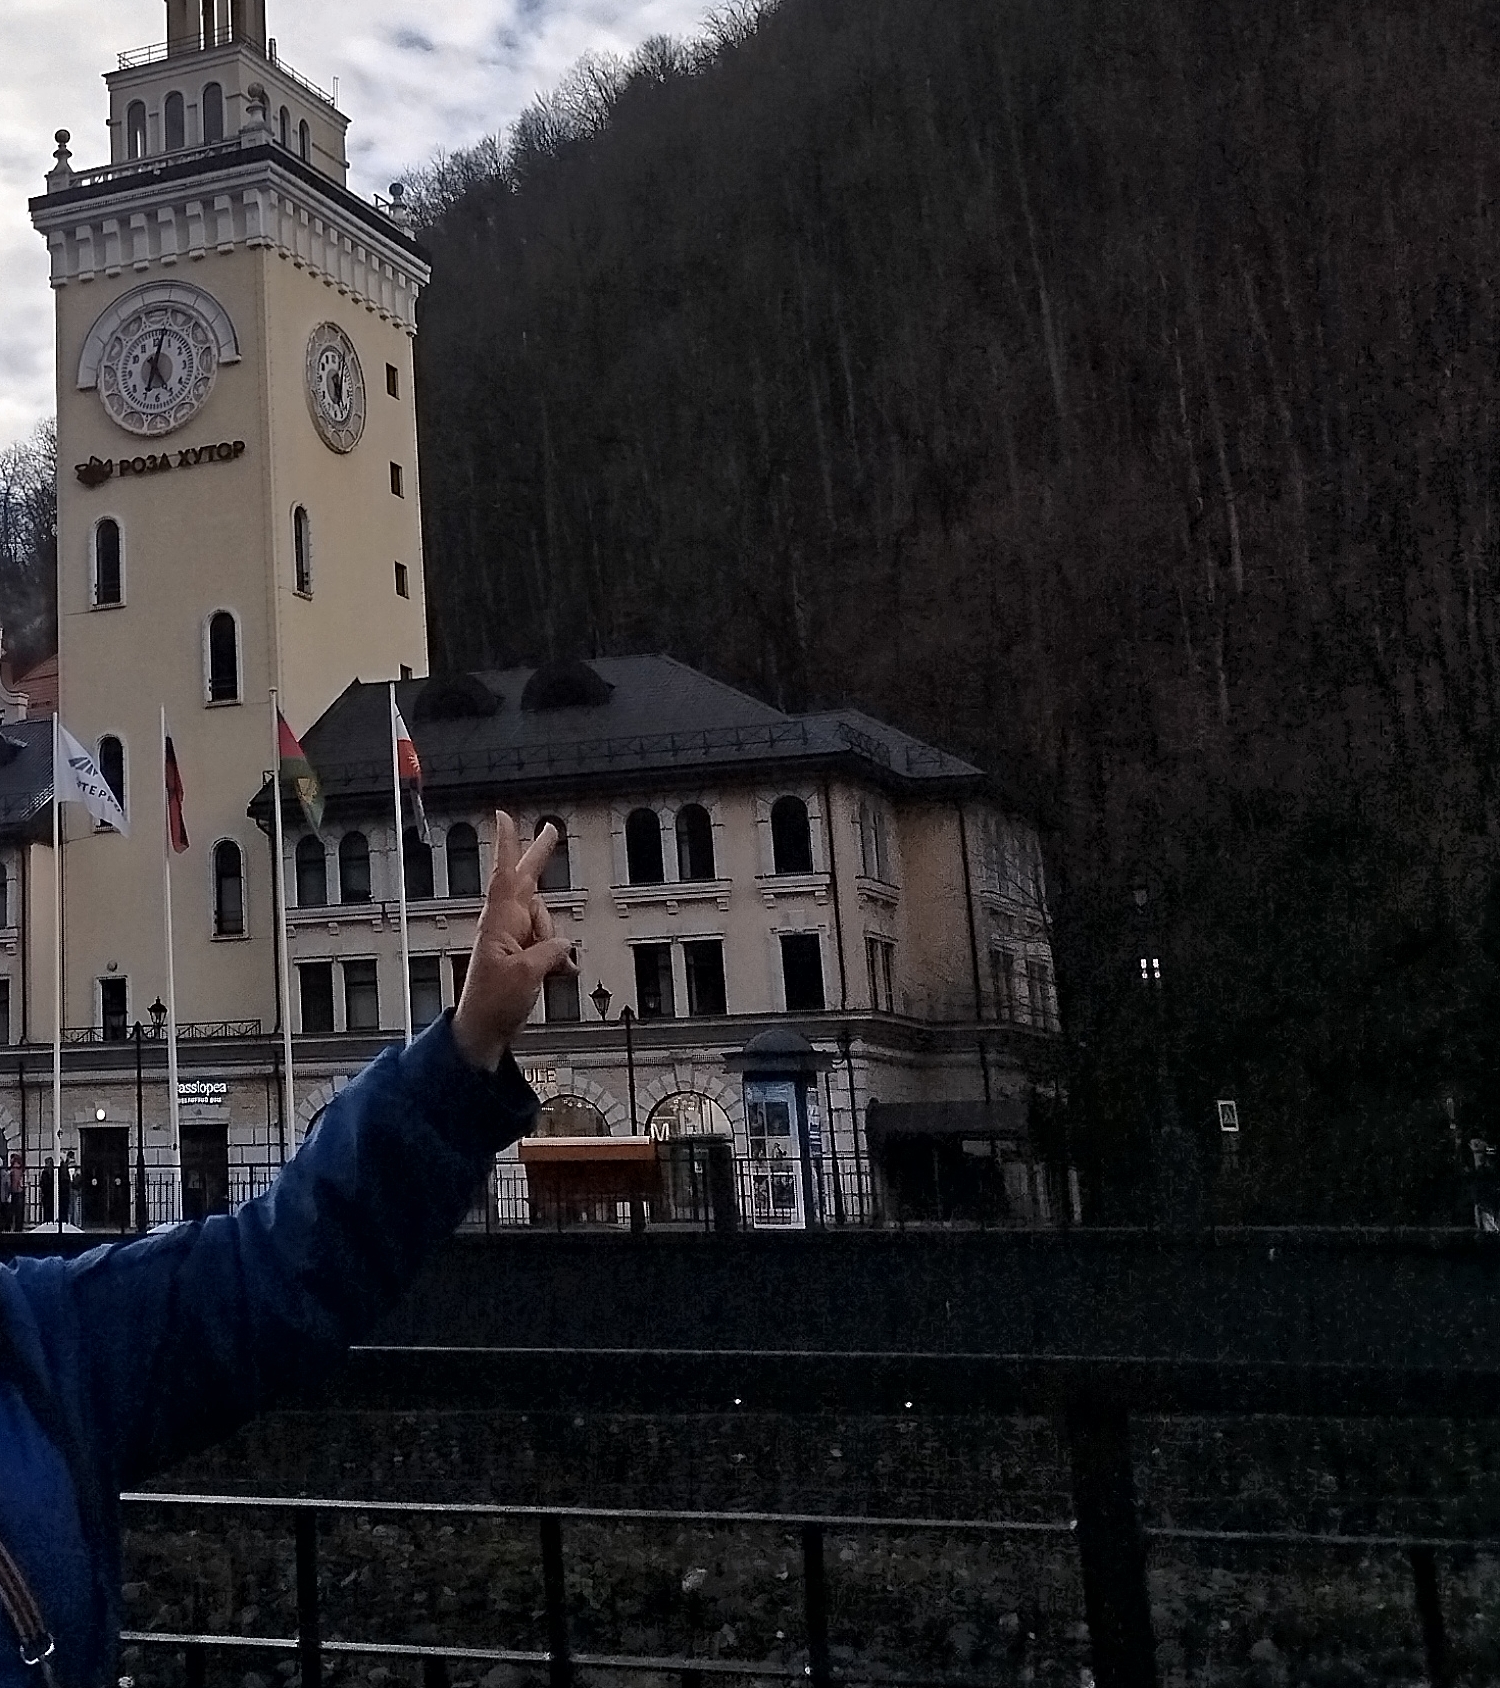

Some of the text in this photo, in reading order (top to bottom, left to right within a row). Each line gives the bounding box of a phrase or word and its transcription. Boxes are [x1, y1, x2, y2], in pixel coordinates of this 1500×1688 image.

[155, 392, 161, 402] 6
[119, 440, 246, 477] РОЗА ХУТОР
[176, 1080, 227, 1096] assiopea
